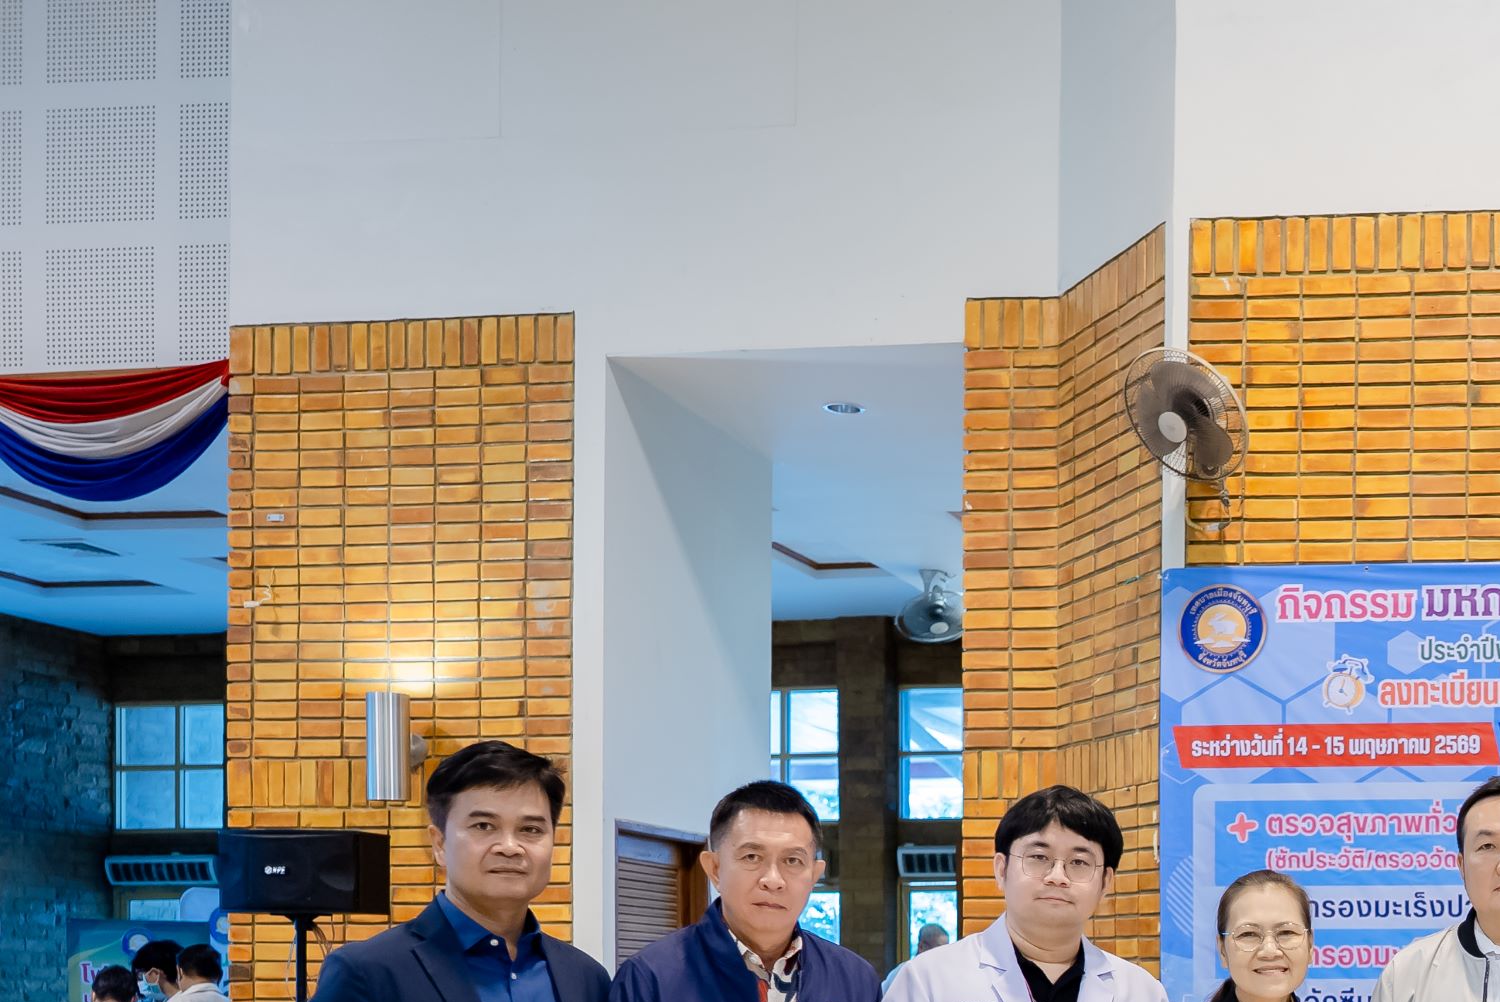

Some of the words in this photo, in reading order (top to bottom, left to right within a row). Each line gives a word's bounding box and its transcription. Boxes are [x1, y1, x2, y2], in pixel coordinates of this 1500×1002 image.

[1278, 586, 1415, 621] กิจกรรม
[1191, 729, 1284, 758] ระหว่างวันที่
[1287, 736, 1308, 756] 14
[1324, 735, 1345, 755] 15
[1348, 735, 1430, 759] พฤษภาคม
[1434, 734, 1481, 755] 2569
[1267, 800, 1461, 842] ตรวจสุขภาพทั่ว
